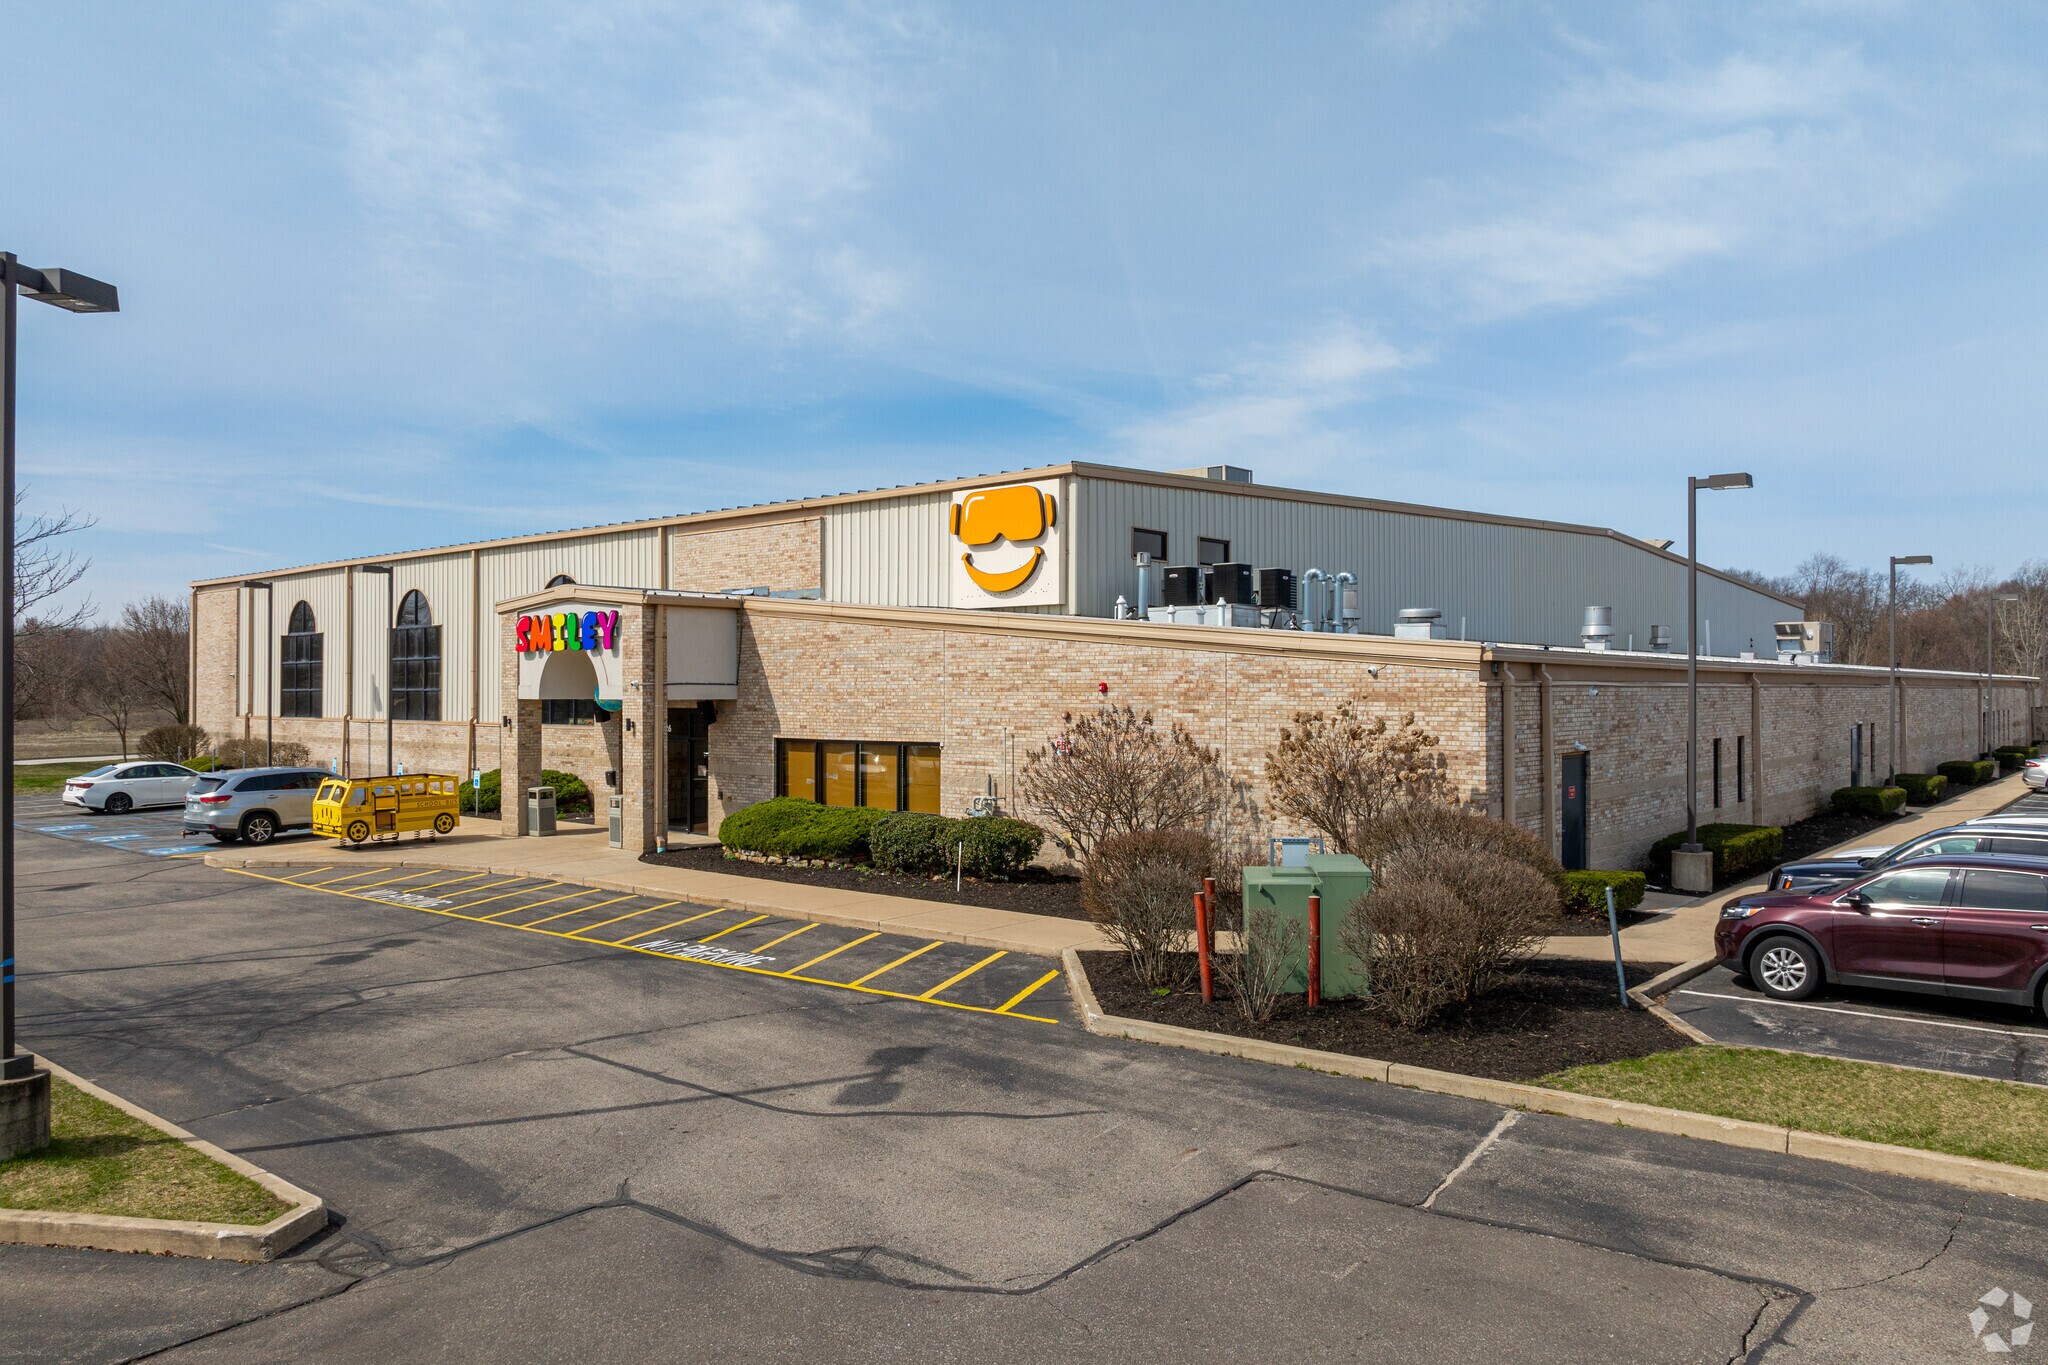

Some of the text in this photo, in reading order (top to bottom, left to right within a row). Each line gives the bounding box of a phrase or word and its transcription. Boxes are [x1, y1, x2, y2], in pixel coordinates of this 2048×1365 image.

[515, 610, 619, 652] SMILEY
[631, 939, 776, 966] NO PARKING
